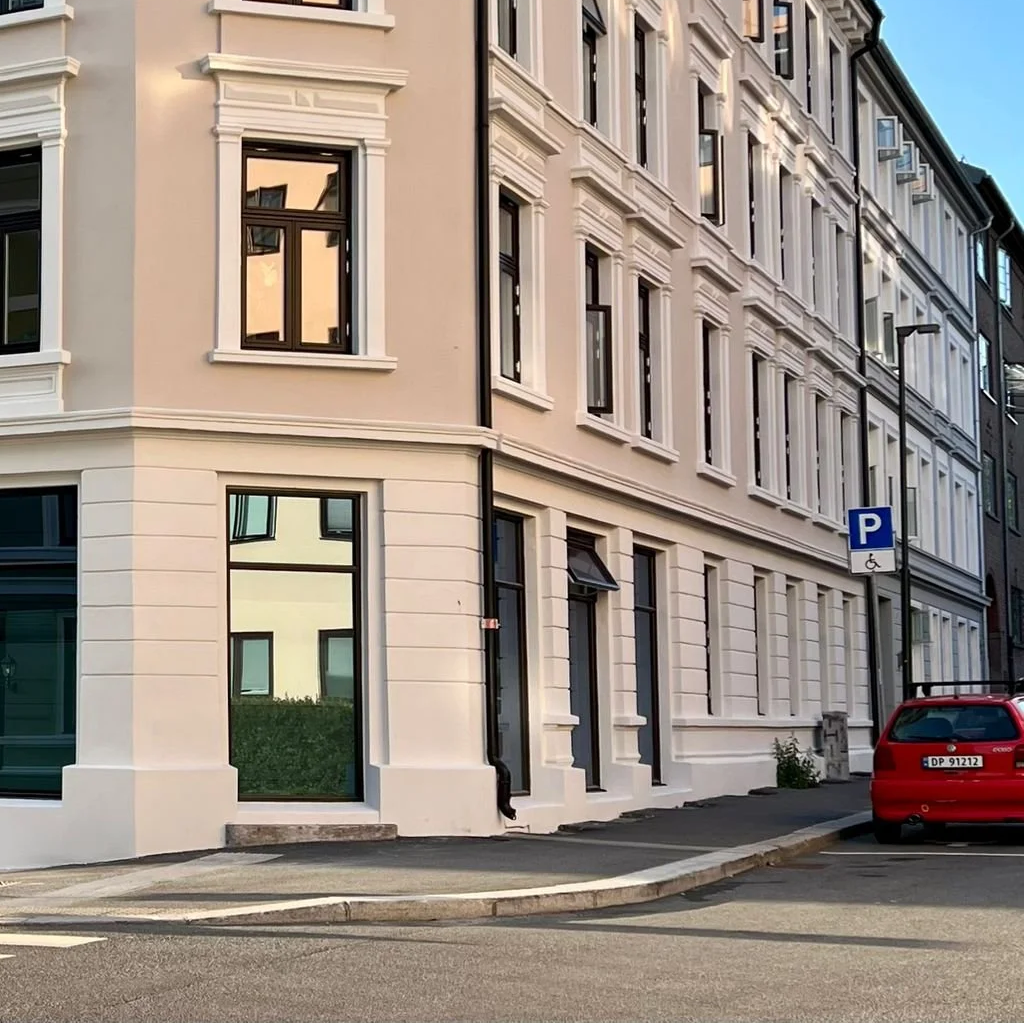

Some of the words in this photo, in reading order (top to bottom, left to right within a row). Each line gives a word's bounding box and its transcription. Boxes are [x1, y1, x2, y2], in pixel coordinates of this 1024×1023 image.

[858, 513, 882, 545] P
[931, 757, 945, 767] DP
[949, 757, 979, 767] 91212
